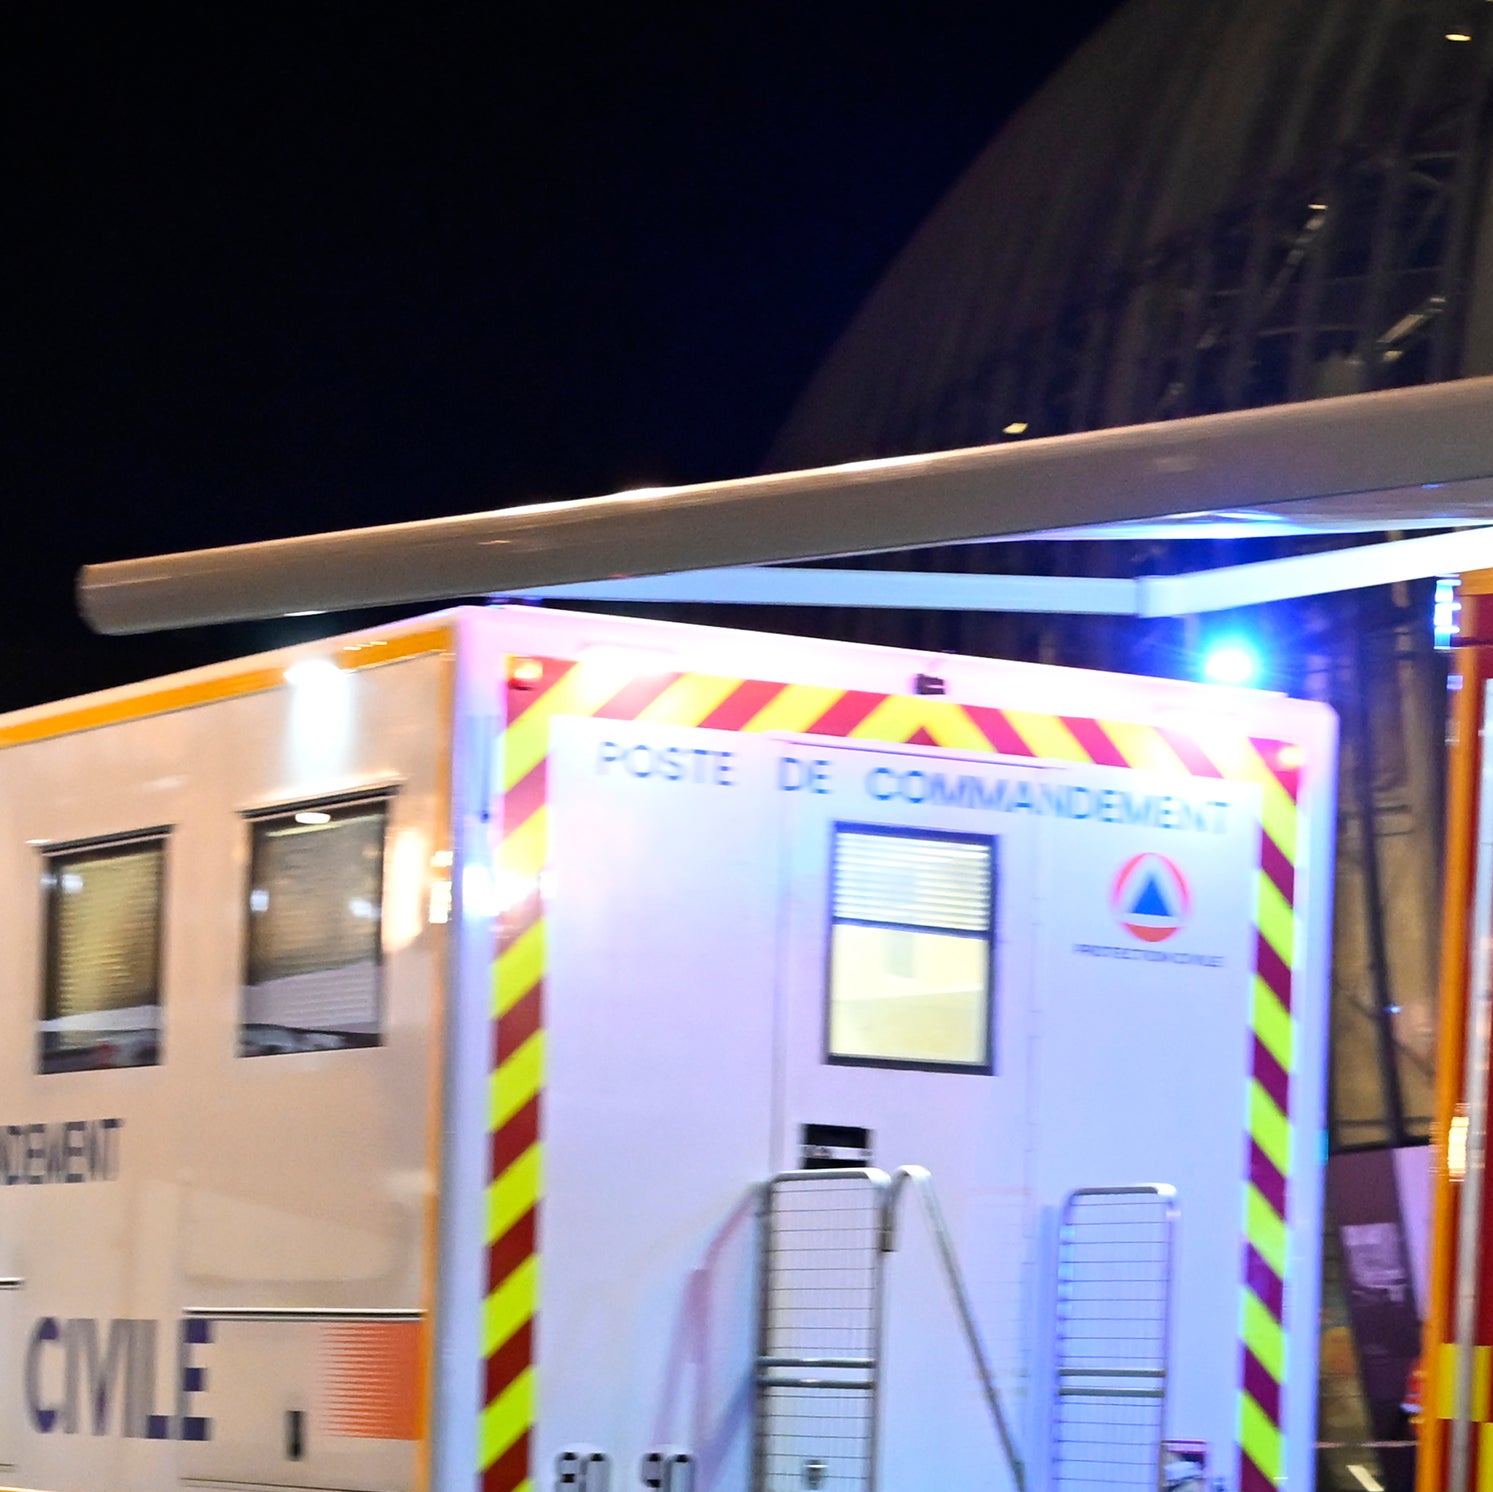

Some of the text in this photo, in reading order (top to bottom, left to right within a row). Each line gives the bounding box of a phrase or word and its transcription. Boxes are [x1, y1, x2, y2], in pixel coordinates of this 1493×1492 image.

[595, 740, 1232, 835] POSTE DE COMMANDEMENT
[0, 1117, 127, 1185] DEMENT
[25, 1316, 214, 1442] CIVILE
